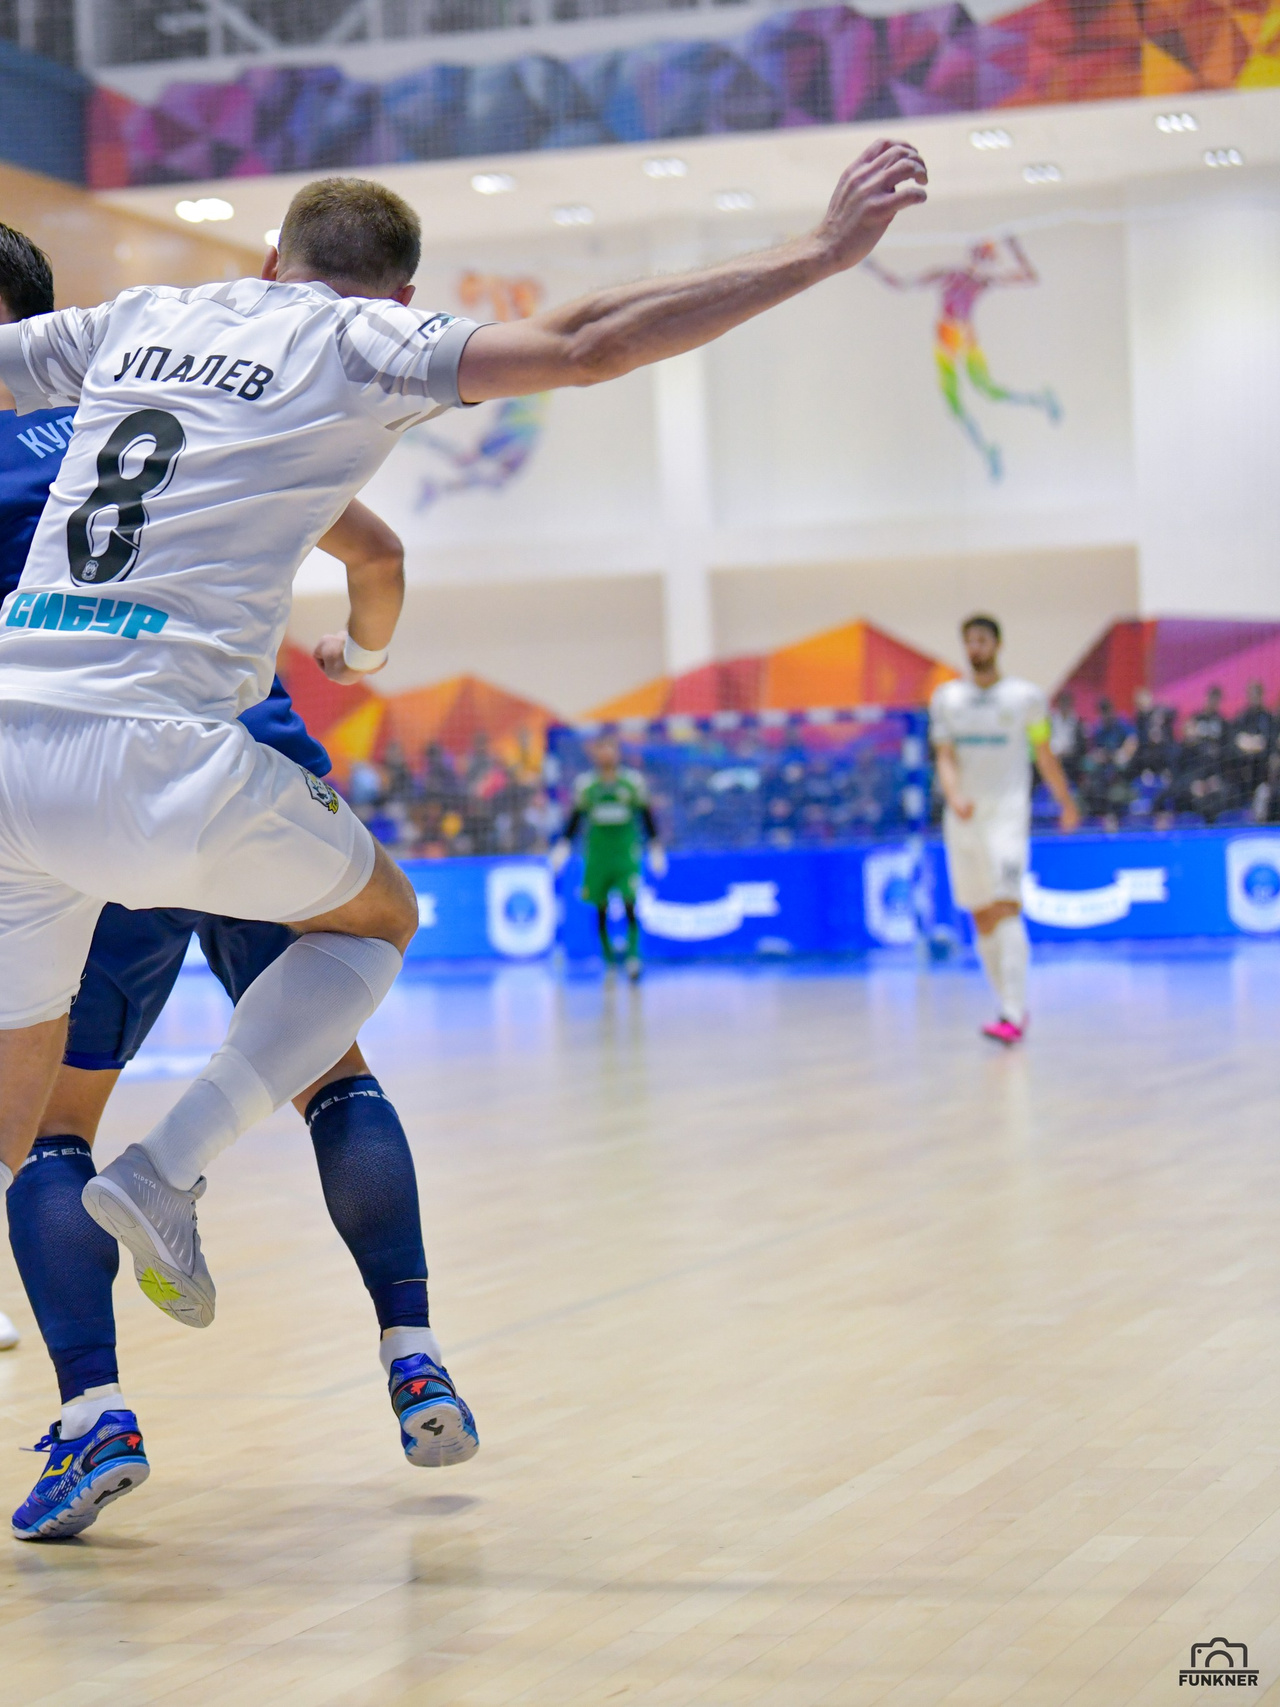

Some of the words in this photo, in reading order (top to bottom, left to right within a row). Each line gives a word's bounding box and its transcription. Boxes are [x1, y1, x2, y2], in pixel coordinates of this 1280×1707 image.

[114, 346, 274, 401] УПАЛЕВ
[67, 409, 186, 587] 8
[6, 593, 169, 640] СИБУР
[310, 1090, 381, 1121] KELME
[132, 1172, 156, 1190] KIPSTA
